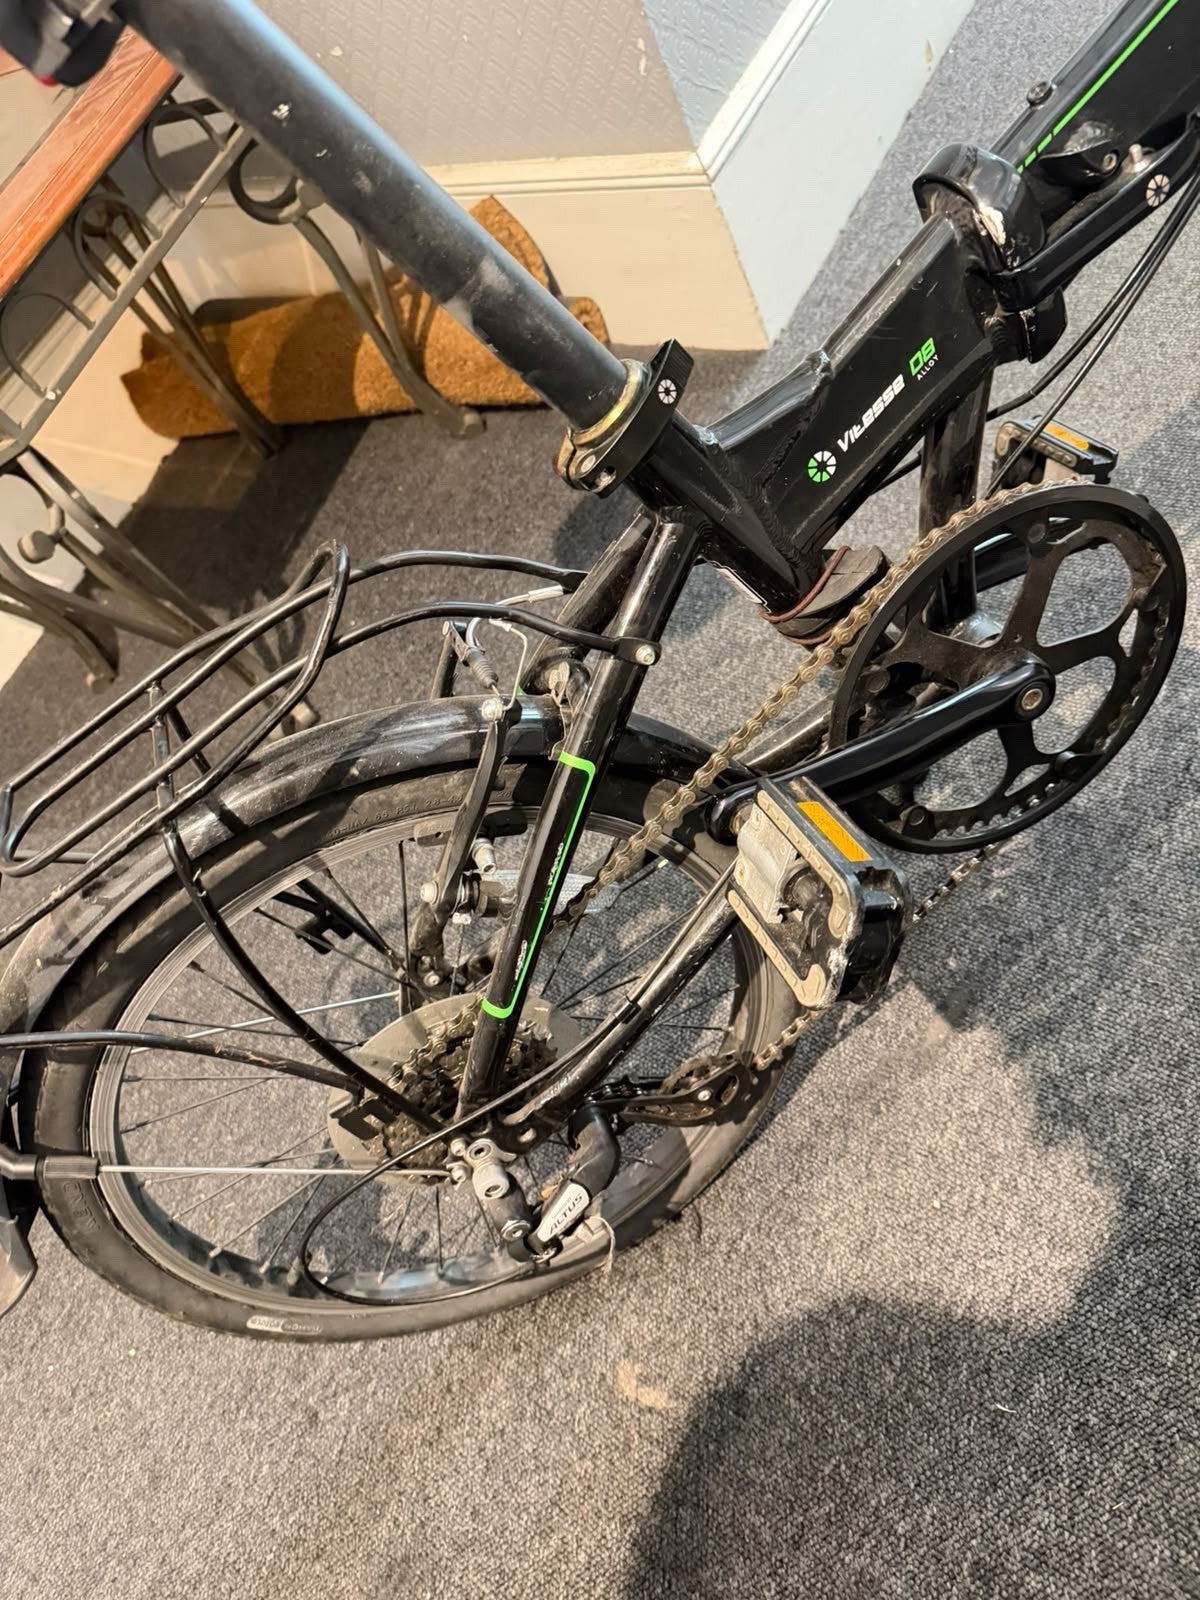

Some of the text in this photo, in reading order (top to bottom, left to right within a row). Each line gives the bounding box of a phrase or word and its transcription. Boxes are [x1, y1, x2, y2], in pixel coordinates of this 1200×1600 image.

[917, 354, 939, 381] ALLOY
[837, 374, 905, 452] Vitesse
[549, 1193, 583, 1235] ALTUS
